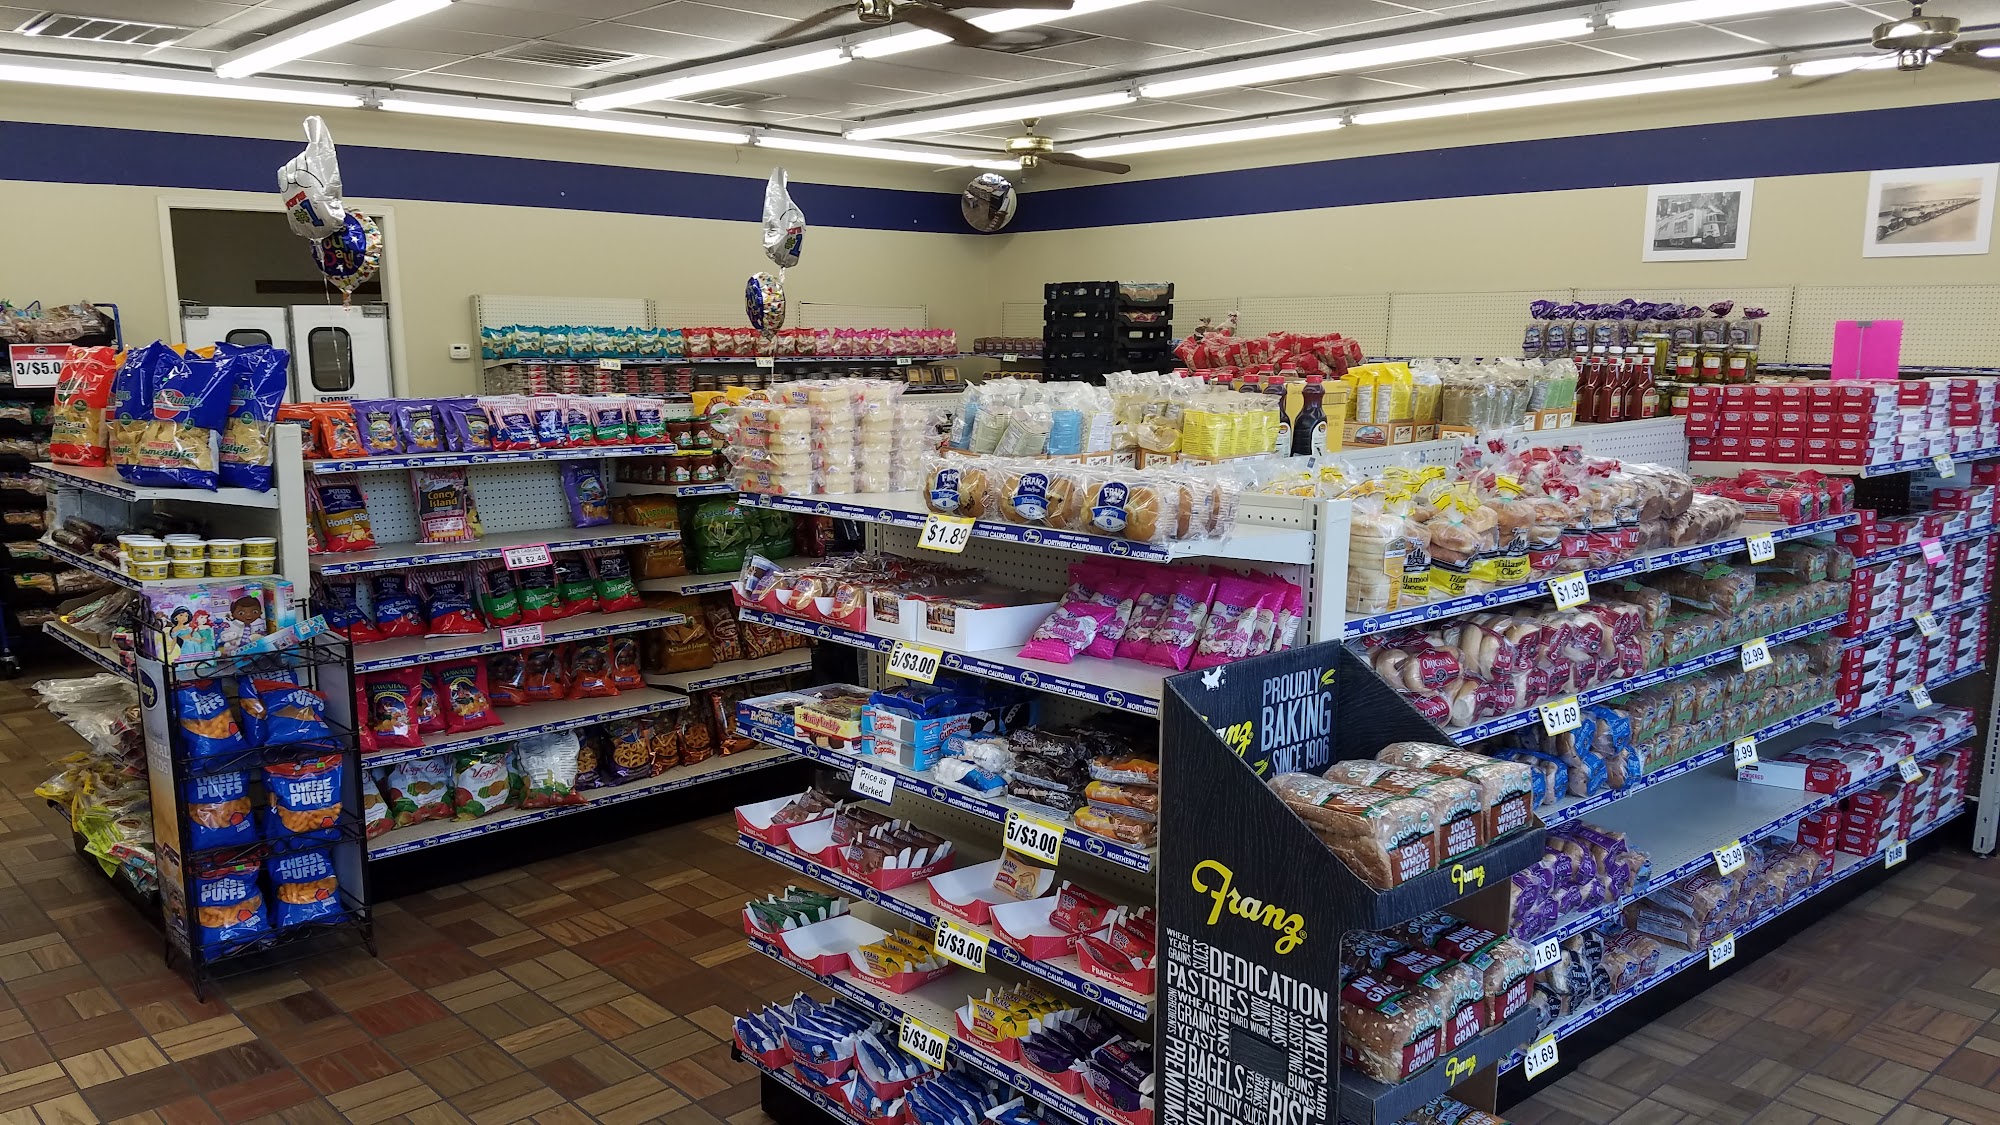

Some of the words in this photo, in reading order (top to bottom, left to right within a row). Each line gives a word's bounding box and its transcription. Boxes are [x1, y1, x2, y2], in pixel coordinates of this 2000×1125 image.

[16, 362, 64, 375] 3/$5.0
[140, 446, 194, 459] Homestyle
[1022, 476, 1046, 488] FRANZ
[428, 491, 455, 500] Coney
[429, 497, 458, 508] Island
[1104, 486, 1125, 499] FRANZ
[327, 515, 353, 528] Honey
[927, 524, 967, 545] $1.89
[1043, 539, 1070, 549] NORTHERN
[1071, 543, 1103, 553] CALIFORNIA
[1131, 550, 1163, 560] NORTHERN
[1752, 543, 1772, 557] $1.99
[525, 555, 546, 563] $2.48
[1557, 582, 1584, 602] $1.99
[521, 634, 541, 643] $2.48
[892, 650, 936, 675] 5/$3.00
[1422, 657, 1454, 670] ORIGINAL
[1743, 651, 1764, 666] $2.99
[963, 664, 987, 676] NORTHERN
[988, 669, 1015, 682] CALIFORNIA
[1041, 682, 1067, 695] NORTHERN
[1068, 688, 1099, 702] CALIFORNIA
[1263, 667, 1322, 706] PROUDLY
[1127, 702, 1157, 714] NORTHERN
[1549, 709, 1576, 727] $1.69
[874, 721, 896, 732] Cupcakes
[942, 718, 967, 731] Chocolate
[1261, 691, 1332, 752] BAKING
[939, 724, 971, 741] Cupcakes
[874, 747, 896, 756] Cupcakes
[1272, 744, 1302, 777] SINCE
[1305, 737, 1329, 769] 1906
[400, 762, 424, 775] Veggie
[860, 770, 877, 783] Price
[878, 777, 888, 786] as
[197, 772, 240, 786] CHEESE
[289, 779, 331, 794] CHEESE
[198, 782, 243, 799] PUFFS
[290, 789, 332, 806] PUFFS
[859, 783, 884, 797] Marked
[948, 797, 972, 811] NORTHERN
[973, 804, 999, 820] CALIFORNIA
[1498, 808, 1527, 827] WHOLE
[1451, 818, 1473, 834] 100%
[1497, 816, 1526, 834] WHEAT
[1007, 822, 1057, 854] 5/$3.00
[1448, 826, 1476, 846] WHOLE
[1400, 841, 1425, 859] 100%
[1448, 838, 1476, 857] WHEAT
[280, 853, 323, 871] CHEESE
[1107, 851, 1136, 865] NORTHERN
[1400, 850, 1429, 871] WHOLE
[1721, 850, 1744, 869] $2.99
[283, 862, 327, 881] PUFFS
[1400, 862, 1430, 881] WHEAT
[1451, 864, 1486, 896] Franz
[201, 878, 245, 893] CHEESE
[201, 887, 246, 902] PUFFS
[1192, 860, 1305, 955] Franz
[1166, 927, 1190, 942] WHEAT
[1446, 925, 1474, 943] NINE
[1459, 930, 1497, 952] GRAIN
[938, 932, 982, 963] 5/$3.00
[1168, 937, 1191, 954] YEAST
[1712, 944, 1733, 962] $2.99
[1168, 947, 1191, 967] GRAINS
[1192, 939, 1209, 974] SLICES
[1021, 961, 1047, 979] NORTHERN
[1048, 971, 1077, 990] CALIFORNIA
[1091, 965, 1112, 980] FRANZ
[1502, 964, 1531, 989] ORGANIC
[1167, 960, 1249, 1017] PASTRIES
[1209, 946, 1328, 1024] DEDICATION
[1507, 981, 1527, 1005] NINE
[976, 1004, 996, 1019] FRANZ
[1178, 991, 1216, 1015] WHEAT
[1251, 995, 1271, 1026] BUNS
[1504, 993, 1527, 1018] GRAIN
[1178, 1003, 1217, 1037] GRAINS
[1231, 1013, 1249, 1029] HARD
[1250, 1020, 1271, 1039] WORK
[1271, 1005, 1288, 1048] GRAINS
[1456, 1005, 1474, 1031] NINE
[901, 1023, 943, 1061] 5/$3.00
[1177, 1023, 1216, 1051] YEAST
[1217, 1007, 1230, 1057] BUNS
[1454, 1020, 1479, 1047] GRAIN
[1288, 1011, 1304, 1075] SATISFYING
[1304, 1017, 1328, 1085] SWEETS
[1414, 1034, 1435, 1057] NINE
[959, 1050, 981, 1068] NORTHERN
[982, 1062, 1010, 1081] CALIFORNIA
[1409, 1049, 1436, 1073] GRAIN
[1527, 1046, 1554, 1073] $1.69
[1164, 1034, 1186, 1122] PREMIUM
[1188, 1043, 1245, 1099] BAGELS
[1446, 1054, 1477, 1086] Franz
[1244, 1070, 1255, 1101] YEAST
[1252, 1071, 1265, 1110] GRAINS
[1262, 1076, 1272, 1111] WHEAT
[1288, 1072, 1315, 1097] BUNS
[1206, 1086, 1242, 1118] QUALITY
[1272, 1080, 1317, 1110] MUFFINS
[1315, 1084, 1328, 1121] HARD
[1033, 1089, 1059, 1108] NORTHERN
[1060, 1103, 1090, 1125] CALIFORNIA
